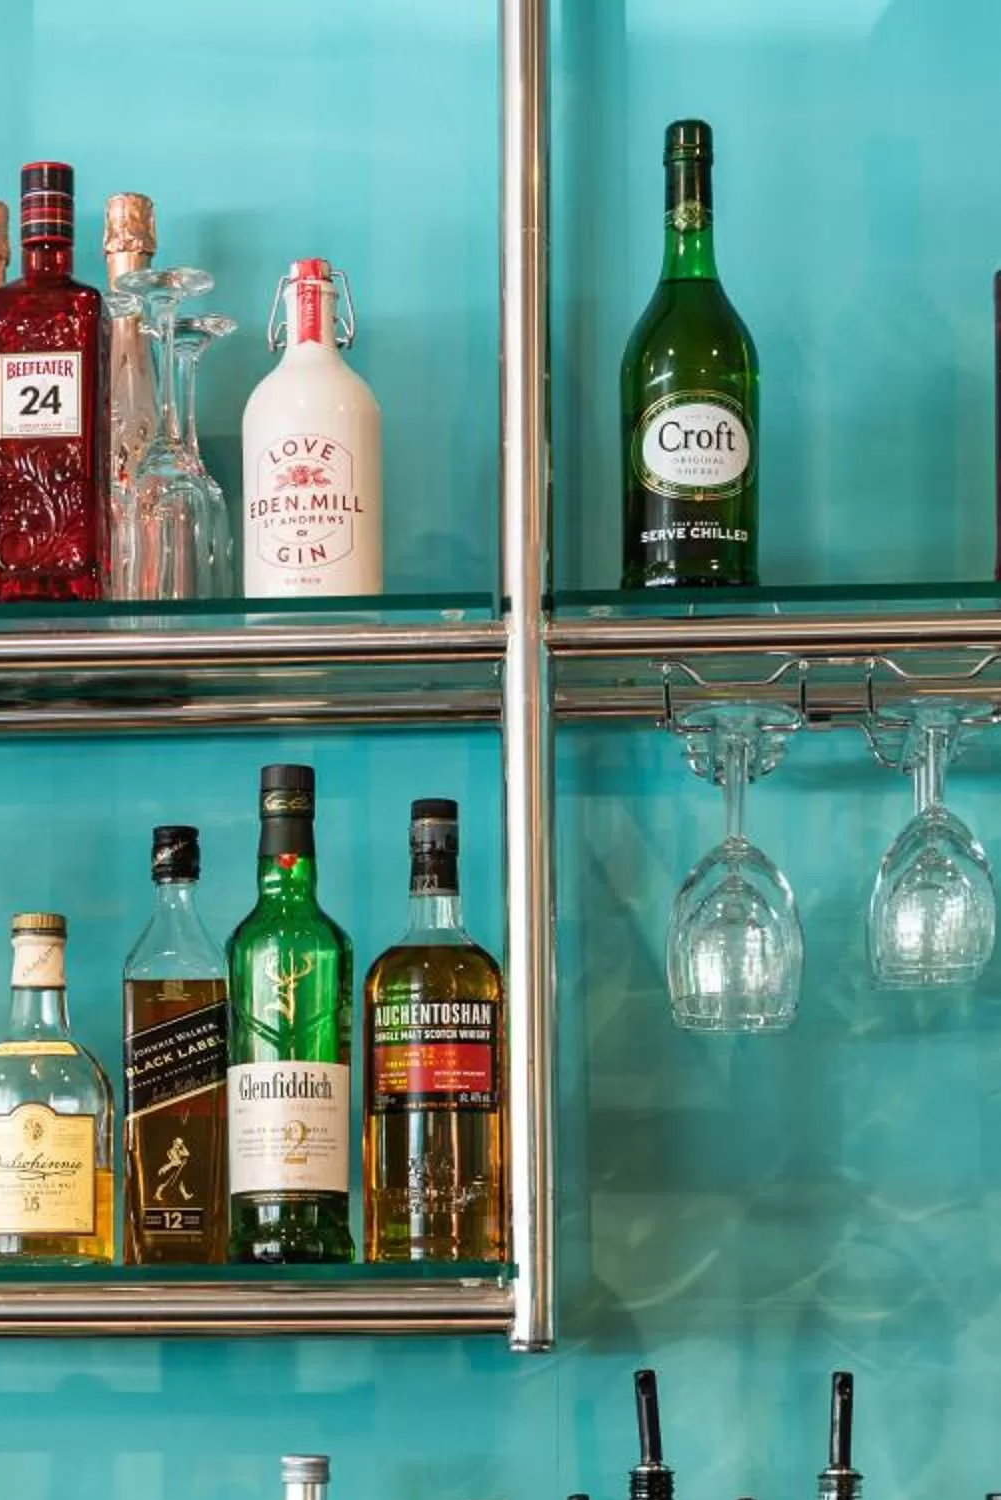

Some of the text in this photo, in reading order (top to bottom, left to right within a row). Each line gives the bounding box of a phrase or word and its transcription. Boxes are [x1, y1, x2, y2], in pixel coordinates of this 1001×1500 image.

[7, 360, 74, 380] BEEFEATER
[20, 385, 62, 415] 24
[658, 421, 735, 452] Croft
[269, 438, 335, 464] LOVE
[640, 527, 748, 543] SERVE CHILLED
[277, 544, 327, 563] GIN
[374, 1003, 492, 1026] AUCHENTOSHAN
[126, 1034, 226, 1079] BLACK LABEL
[239, 1071, 335, 1101] Glenfiddich
[162, 1212, 183, 1229] 12
